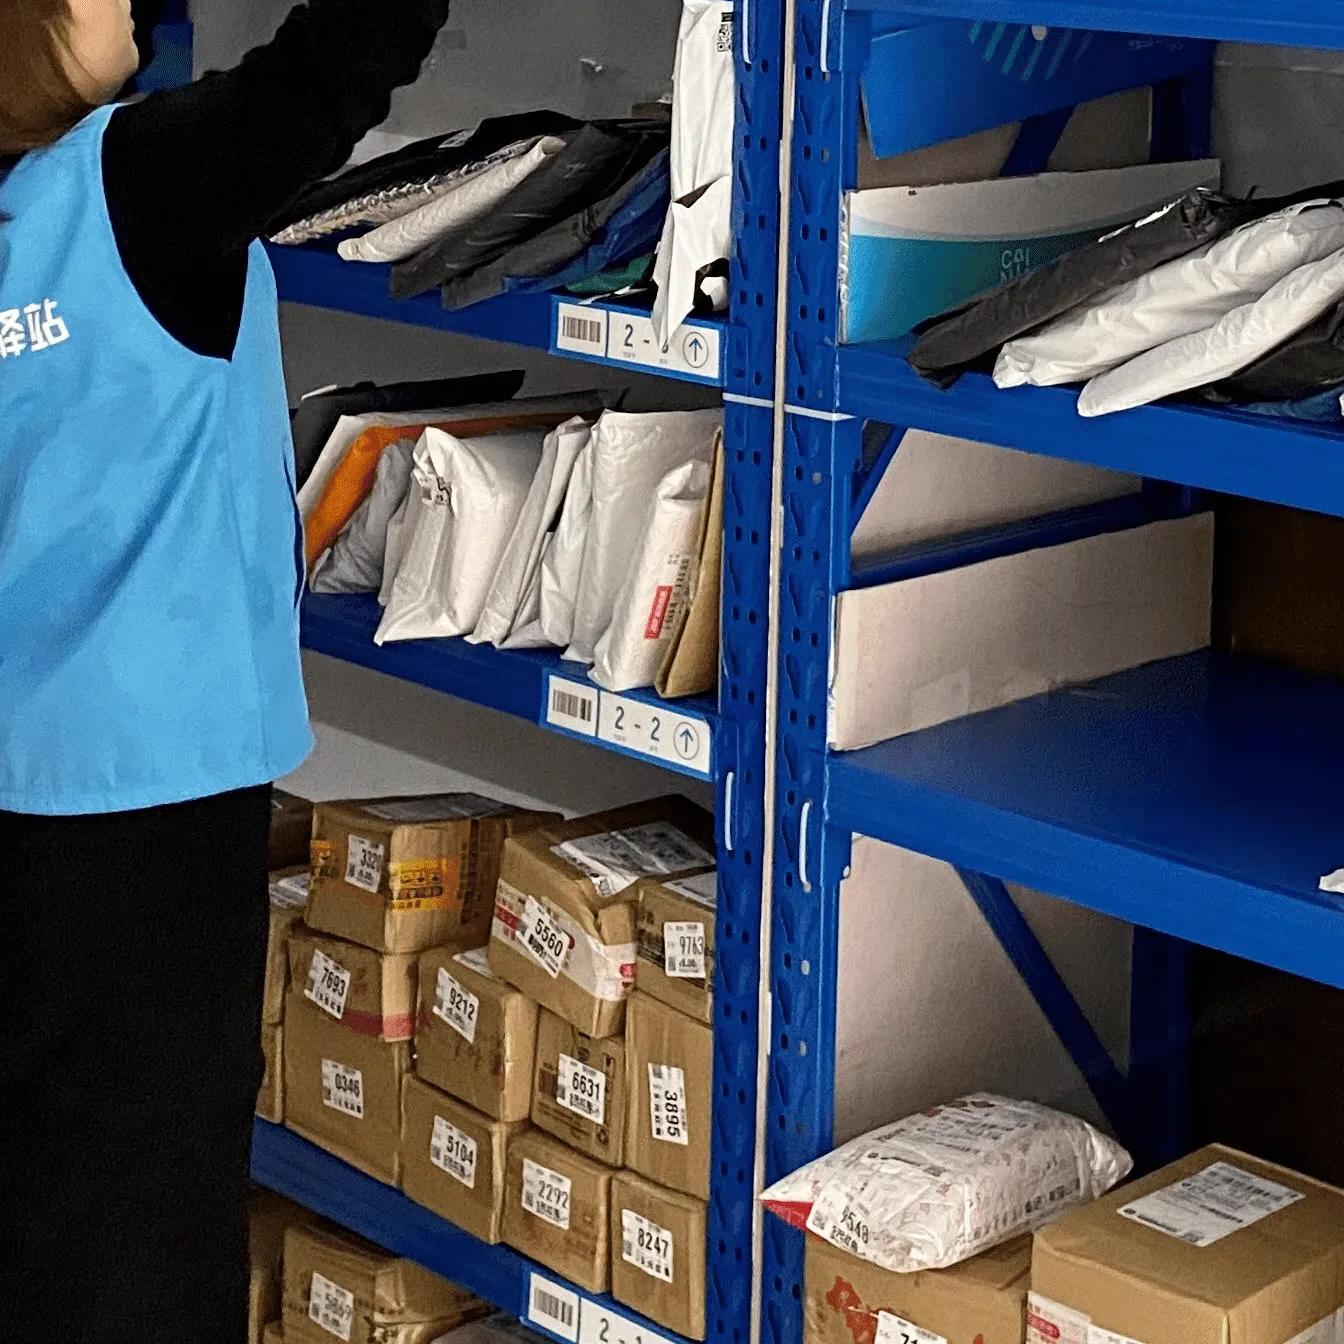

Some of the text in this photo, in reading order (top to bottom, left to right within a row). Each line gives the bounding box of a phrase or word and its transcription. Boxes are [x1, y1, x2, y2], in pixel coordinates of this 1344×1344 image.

[321, 965, 346, 998] 7693
[449, 987, 476, 1022] 9212
[571, 1070, 601, 1102] 6631
[663, 1090, 680, 1138] 3895
[446, 1135, 474, 1167] 5104
[638, 1227, 669, 1257] 8247
